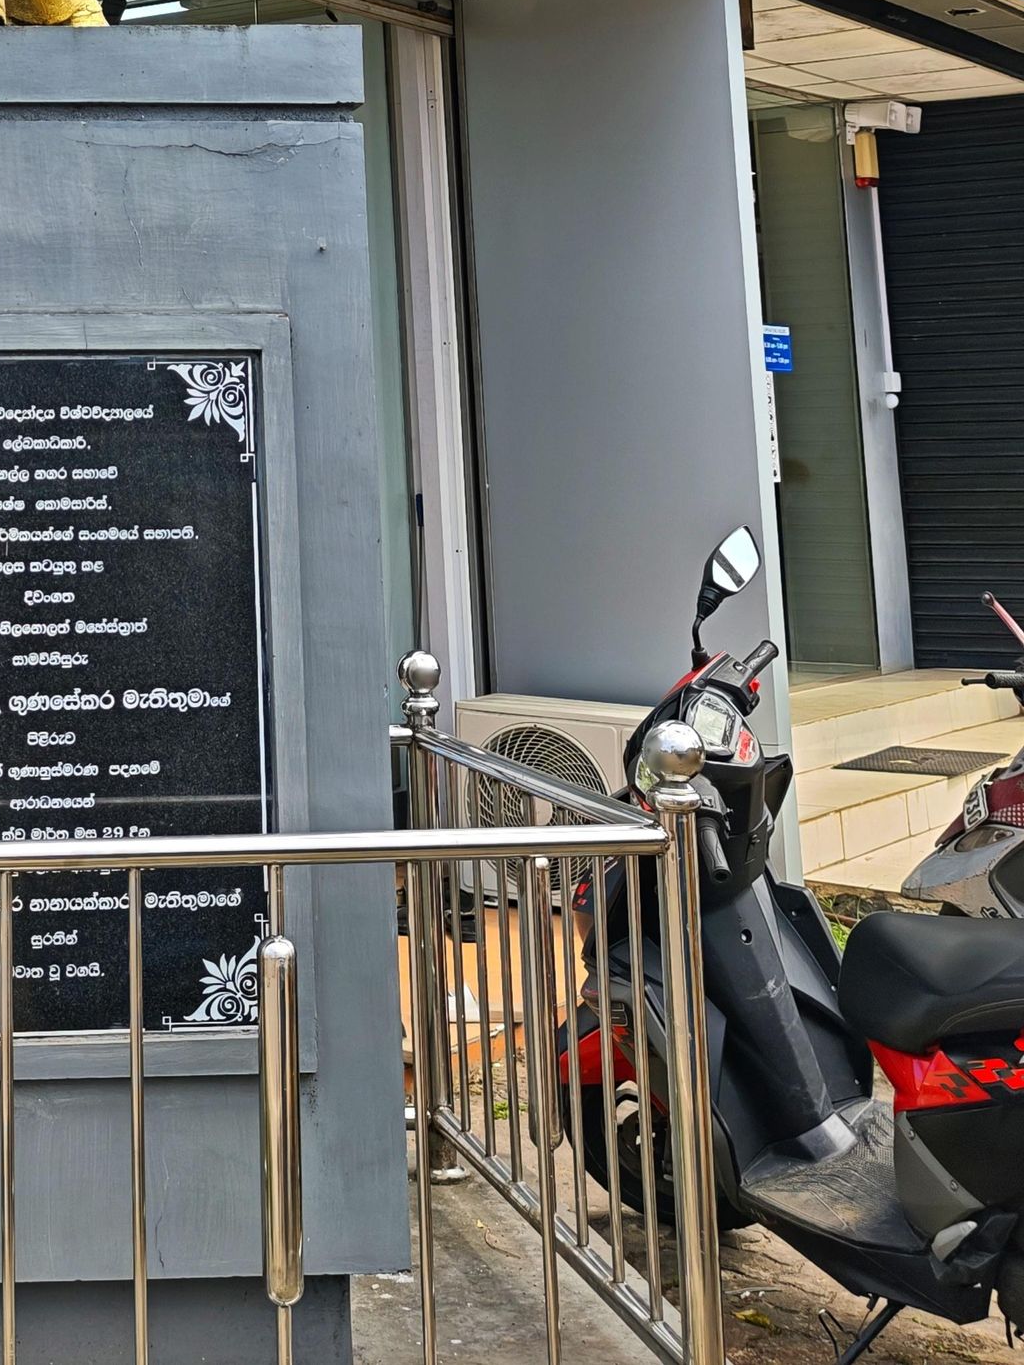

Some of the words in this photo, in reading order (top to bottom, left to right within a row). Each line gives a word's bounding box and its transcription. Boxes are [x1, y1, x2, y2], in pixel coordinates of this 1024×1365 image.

[33, 467, 68, 480] නගර
[78, 525, 140, 541] සංගමයේ
[29, 559, 77, 574] කටයුතු
[81, 559, 105, 573] කළ
[11, 652, 89, 669] සාමවිනිසුරු
[8, 688, 115, 716] ගුණසේකර
[122, 688, 231, 713] මැතිතුමාගේ
[10, 792, 95, 811] ආරාධනයෙන්
[144, 888, 241, 910] මැතිතුමාගේ
[31, 929, 78, 949] සුරතින්
[48, 963, 62, 982] වූ
